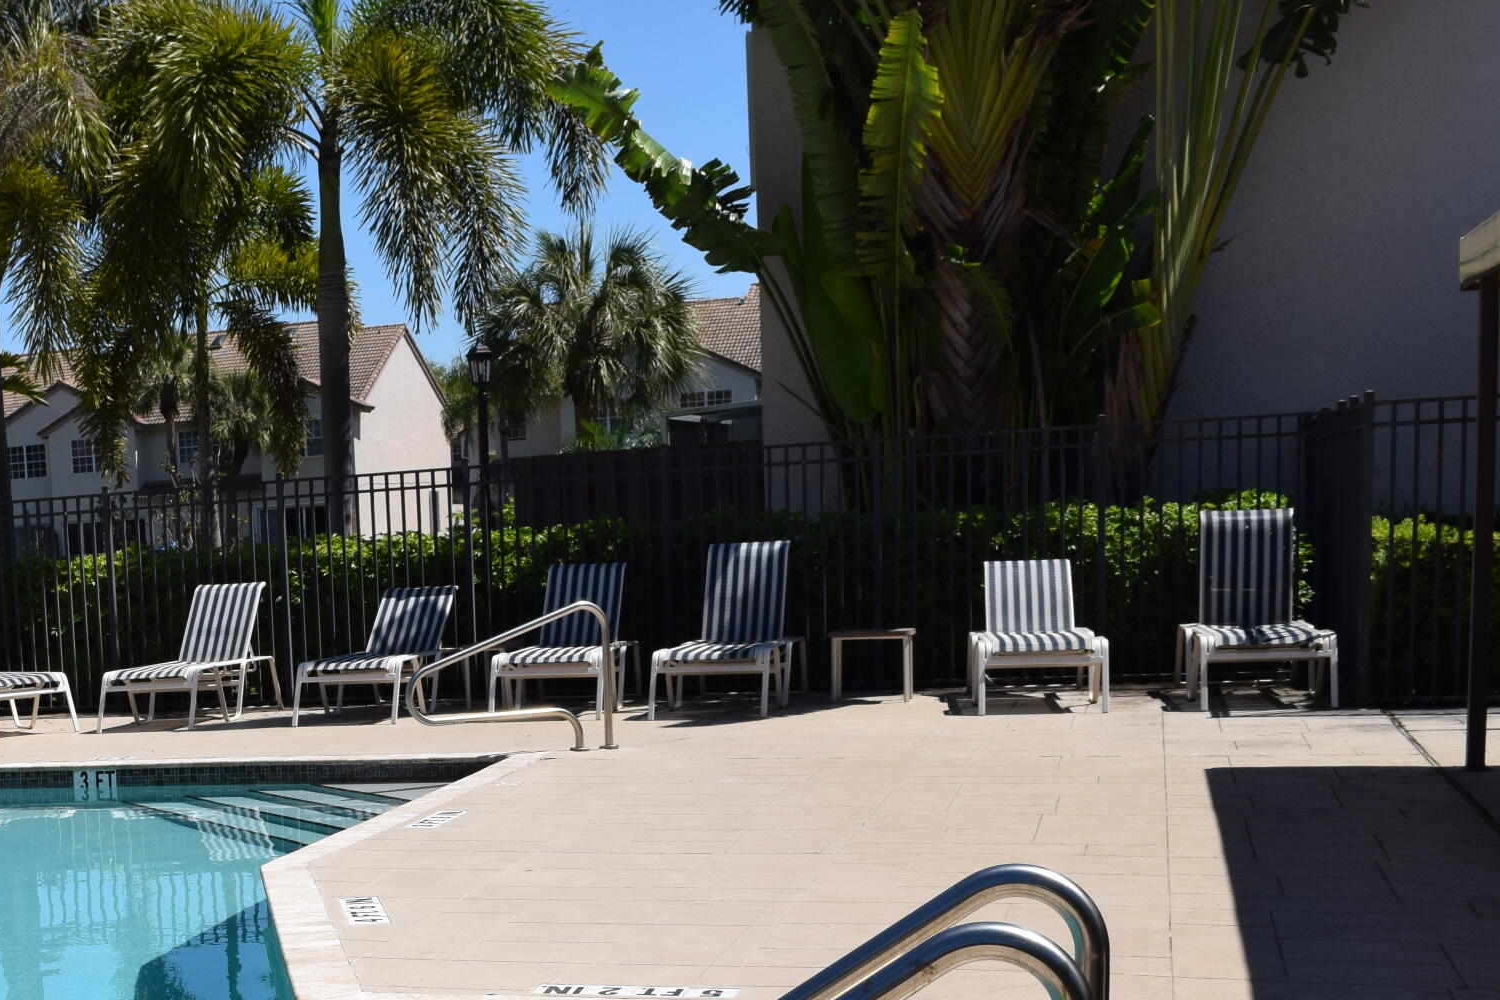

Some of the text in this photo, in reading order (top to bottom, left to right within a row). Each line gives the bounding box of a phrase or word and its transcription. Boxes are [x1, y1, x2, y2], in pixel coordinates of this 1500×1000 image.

[80, 770, 115, 788] 3 FT
[598, 987, 622, 996] 2
[700, 989, 724, 997] 5
